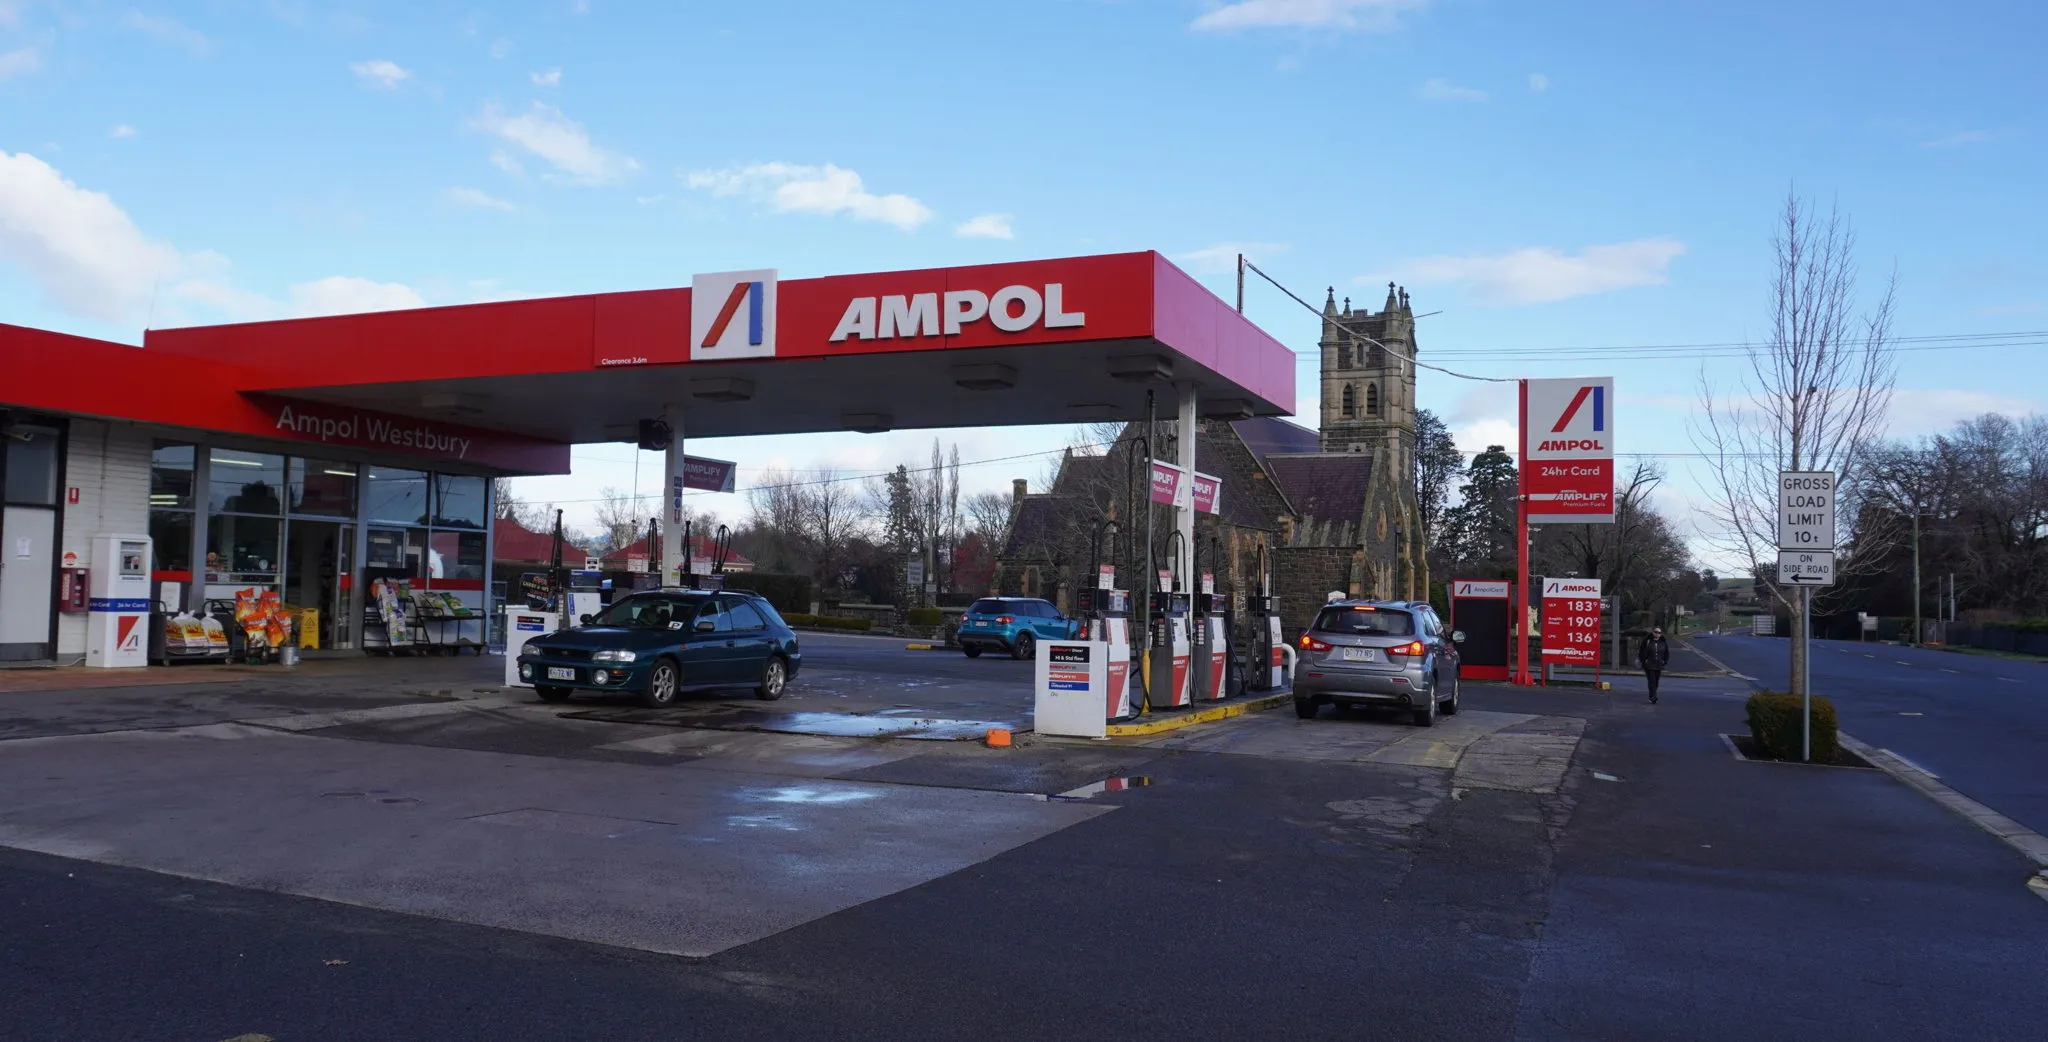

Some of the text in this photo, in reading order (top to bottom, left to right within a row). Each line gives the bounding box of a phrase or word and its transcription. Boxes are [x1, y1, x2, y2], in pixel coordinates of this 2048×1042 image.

[829, 283, 1085, 342] AMPOL
[276, 405, 470, 459] Ampol Westbury
[1538, 440, 1604, 451] AMPOL
[1541, 466, 1600, 476] 24hr Card
[1784, 478, 1830, 490] GROSS
[1555, 493, 1608, 501] AMPLIFY
[1787, 496, 1826, 508] LOAD
[1788, 513, 1825, 525] LIMIT
[1800, 554, 1813, 562] ON
[1783, 564, 1829, 574] SIDE ROAD
